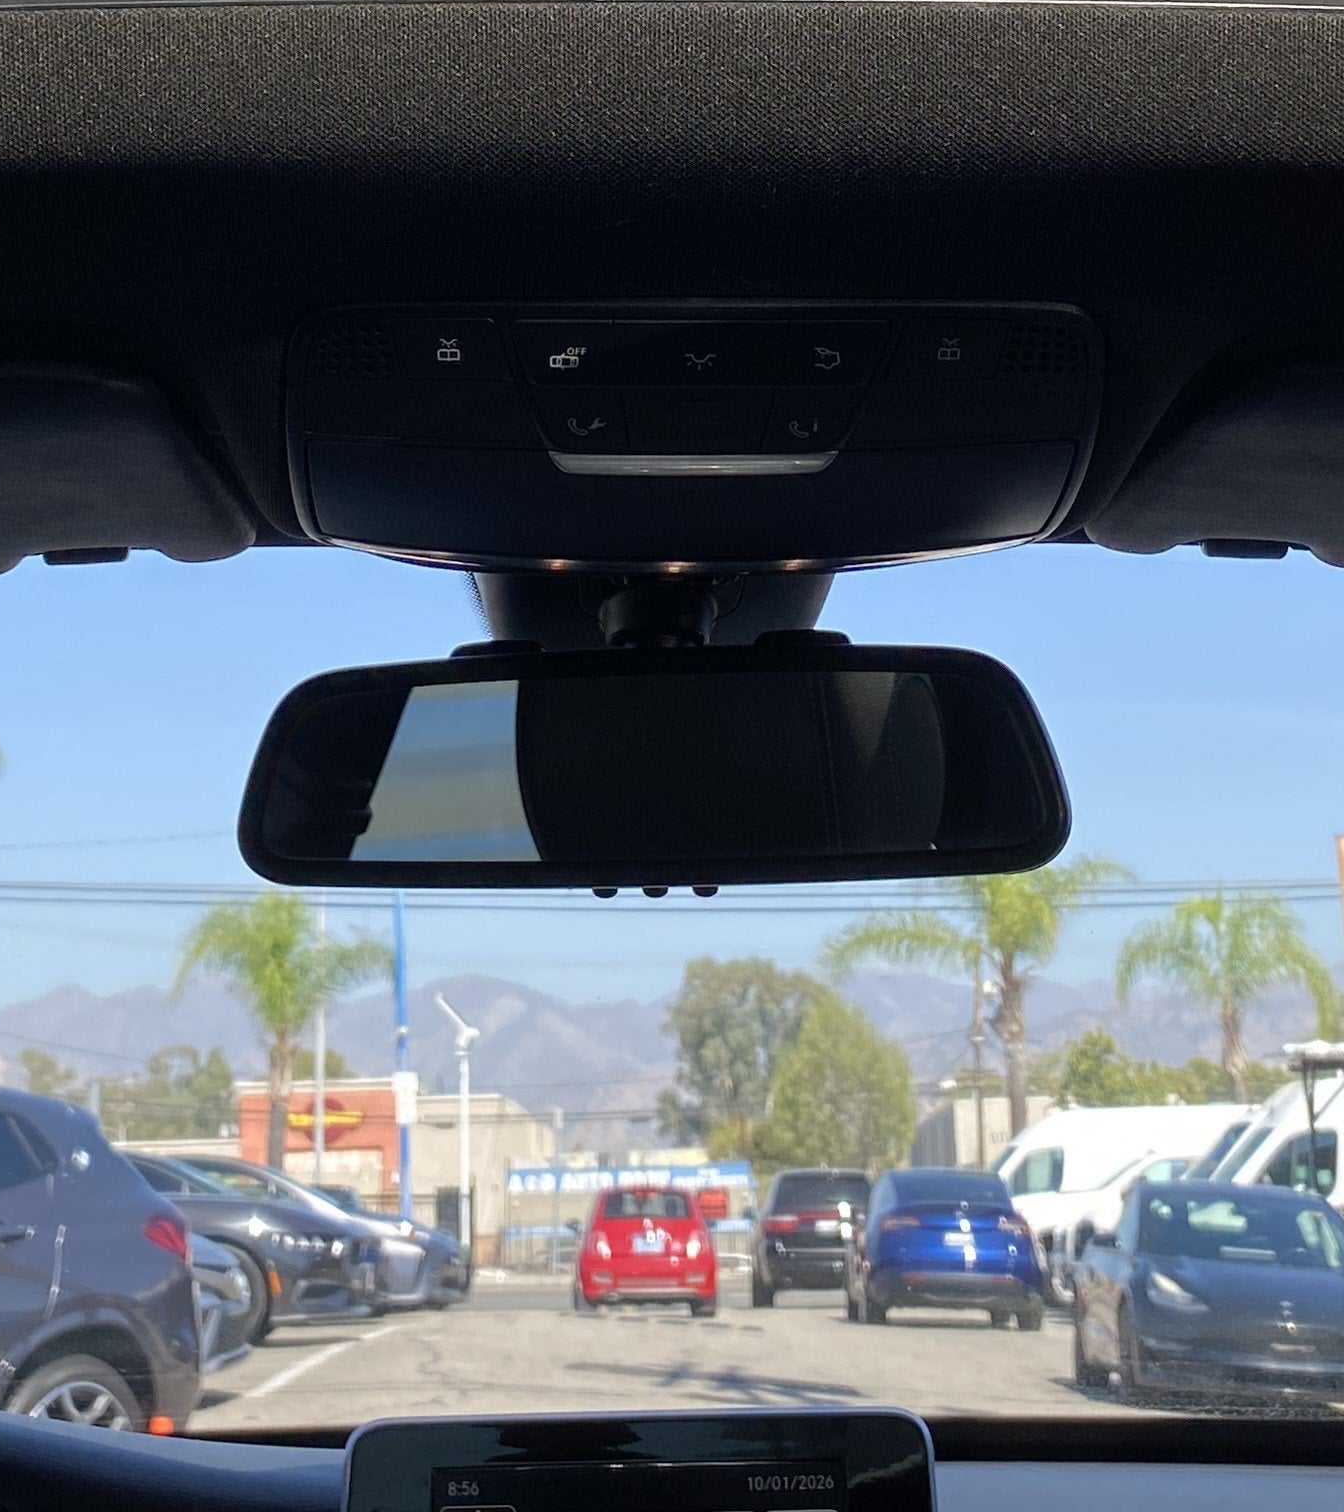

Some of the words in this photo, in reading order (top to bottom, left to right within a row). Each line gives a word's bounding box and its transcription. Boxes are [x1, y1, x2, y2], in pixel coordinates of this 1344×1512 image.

[567, 346, 587, 356] OFF
[447, 1479, 480, 1496] 8:56
[747, 1474, 835, 1492] 10/01/2026
